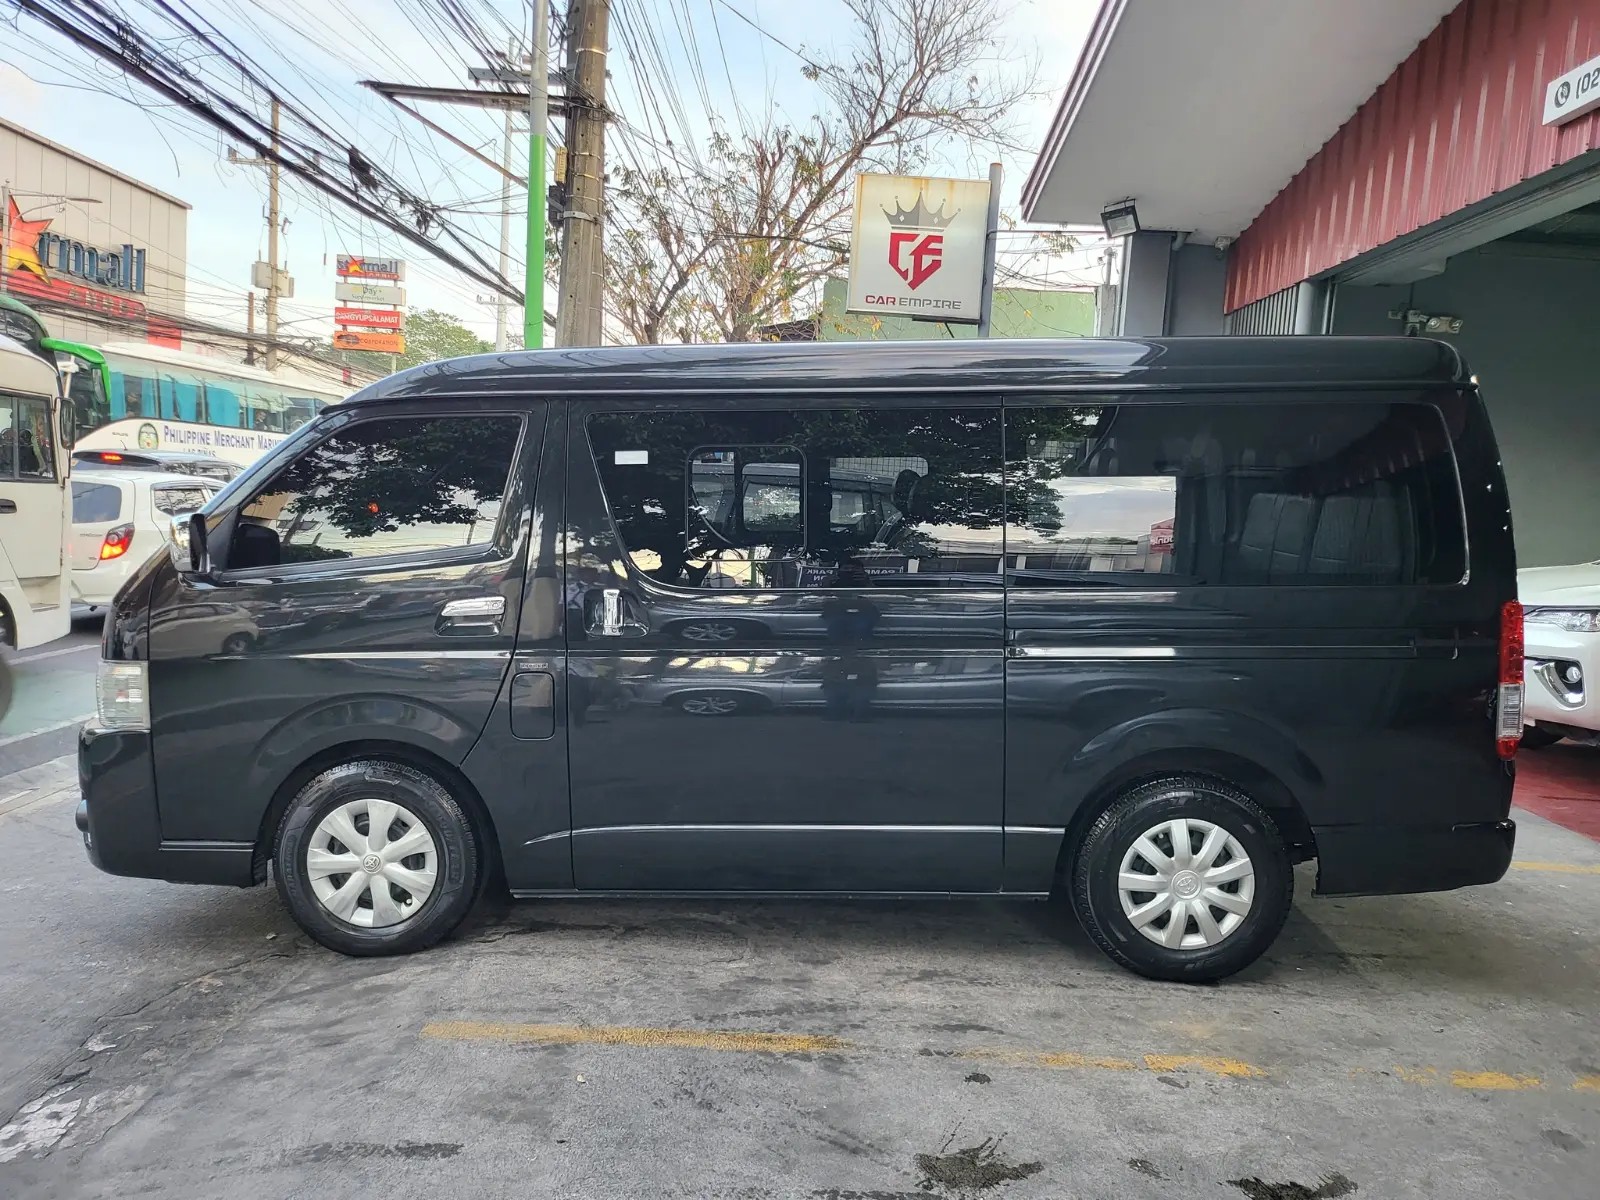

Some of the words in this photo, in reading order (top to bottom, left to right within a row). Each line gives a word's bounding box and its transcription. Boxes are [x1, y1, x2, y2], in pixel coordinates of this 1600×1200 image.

[865, 294, 896, 306] CAR
[898, 297, 962, 310] EMPIRE
[163, 425, 211, 446] PHILIPPINE
[213, 430, 255, 449] MERCHANT
